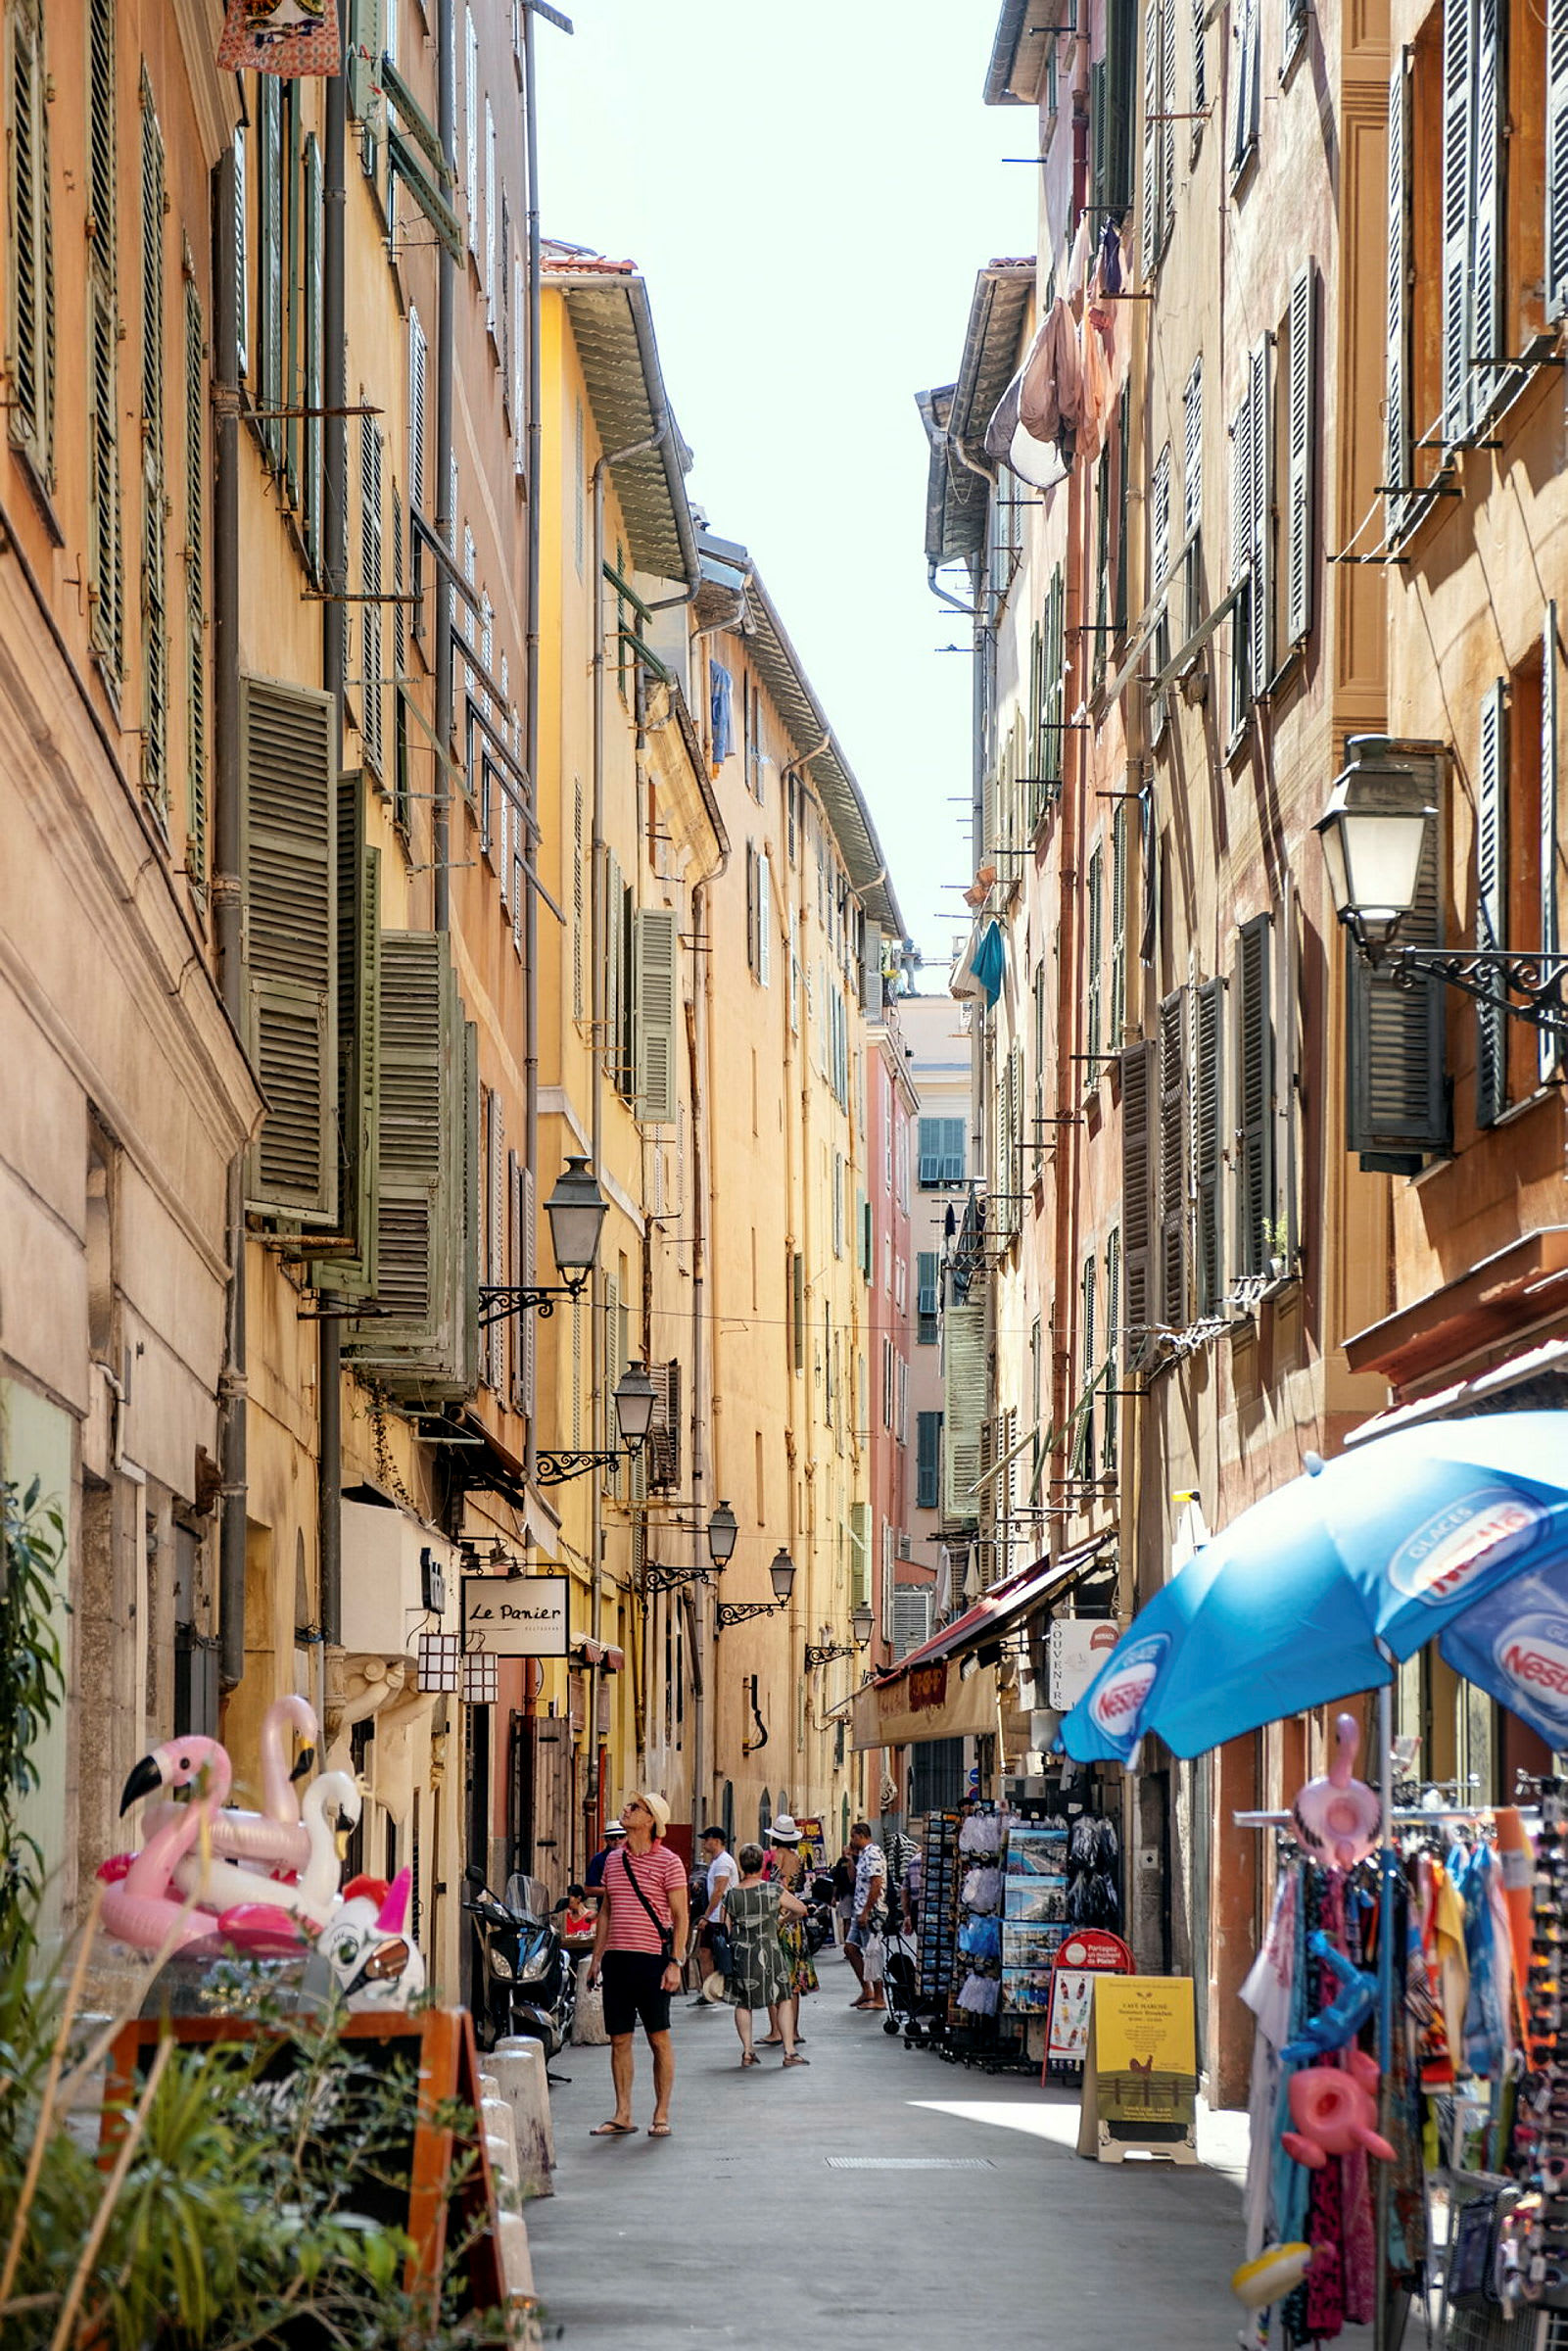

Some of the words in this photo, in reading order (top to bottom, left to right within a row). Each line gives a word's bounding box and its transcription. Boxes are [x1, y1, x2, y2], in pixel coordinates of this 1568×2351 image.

[1408, 1506, 1474, 1559] GLACES
[469, 1604, 494, 1620] Le
[500, 1604, 561, 1620] Panier
[1053, 1619, 1063, 1709] SOUVENIRS
